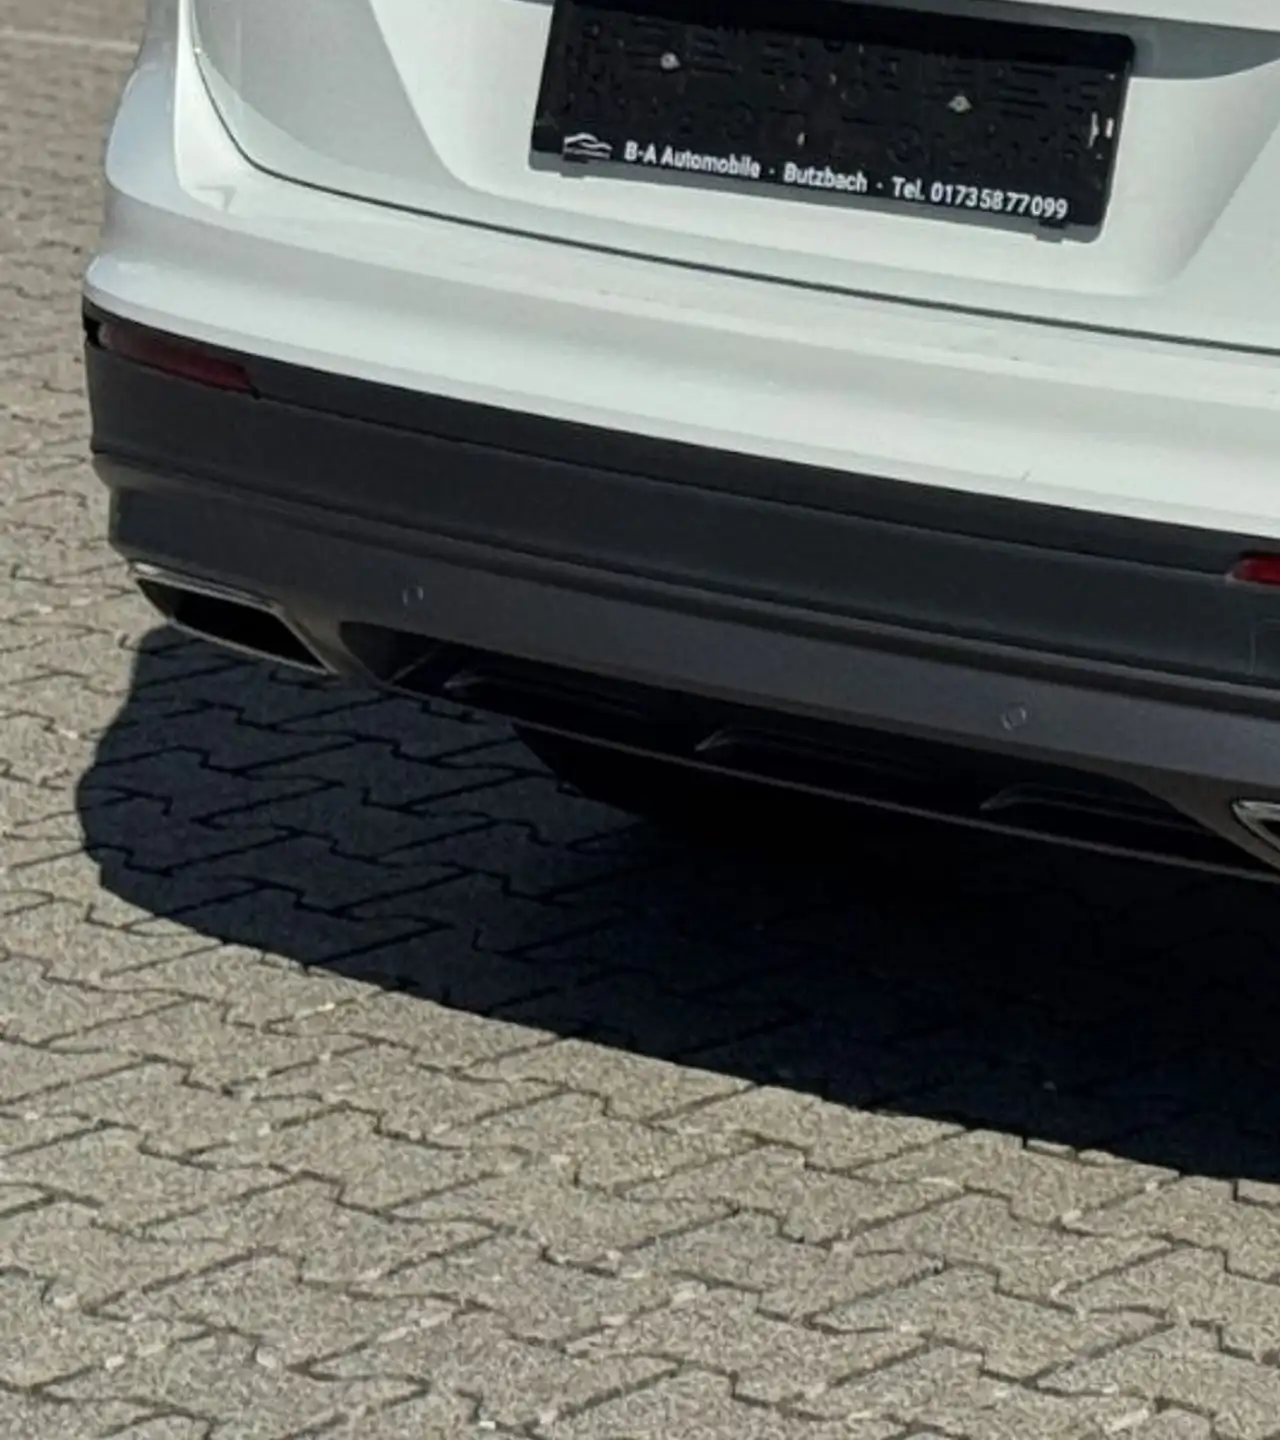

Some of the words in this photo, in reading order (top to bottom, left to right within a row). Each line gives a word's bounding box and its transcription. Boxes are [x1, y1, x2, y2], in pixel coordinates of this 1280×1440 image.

[660, 145, 761, 179] Automobile
[783, 161, 868, 194] Butzbach
[891, 176, 925, 201] Tel.
[930, 181, 1069, 220] 01735877099
